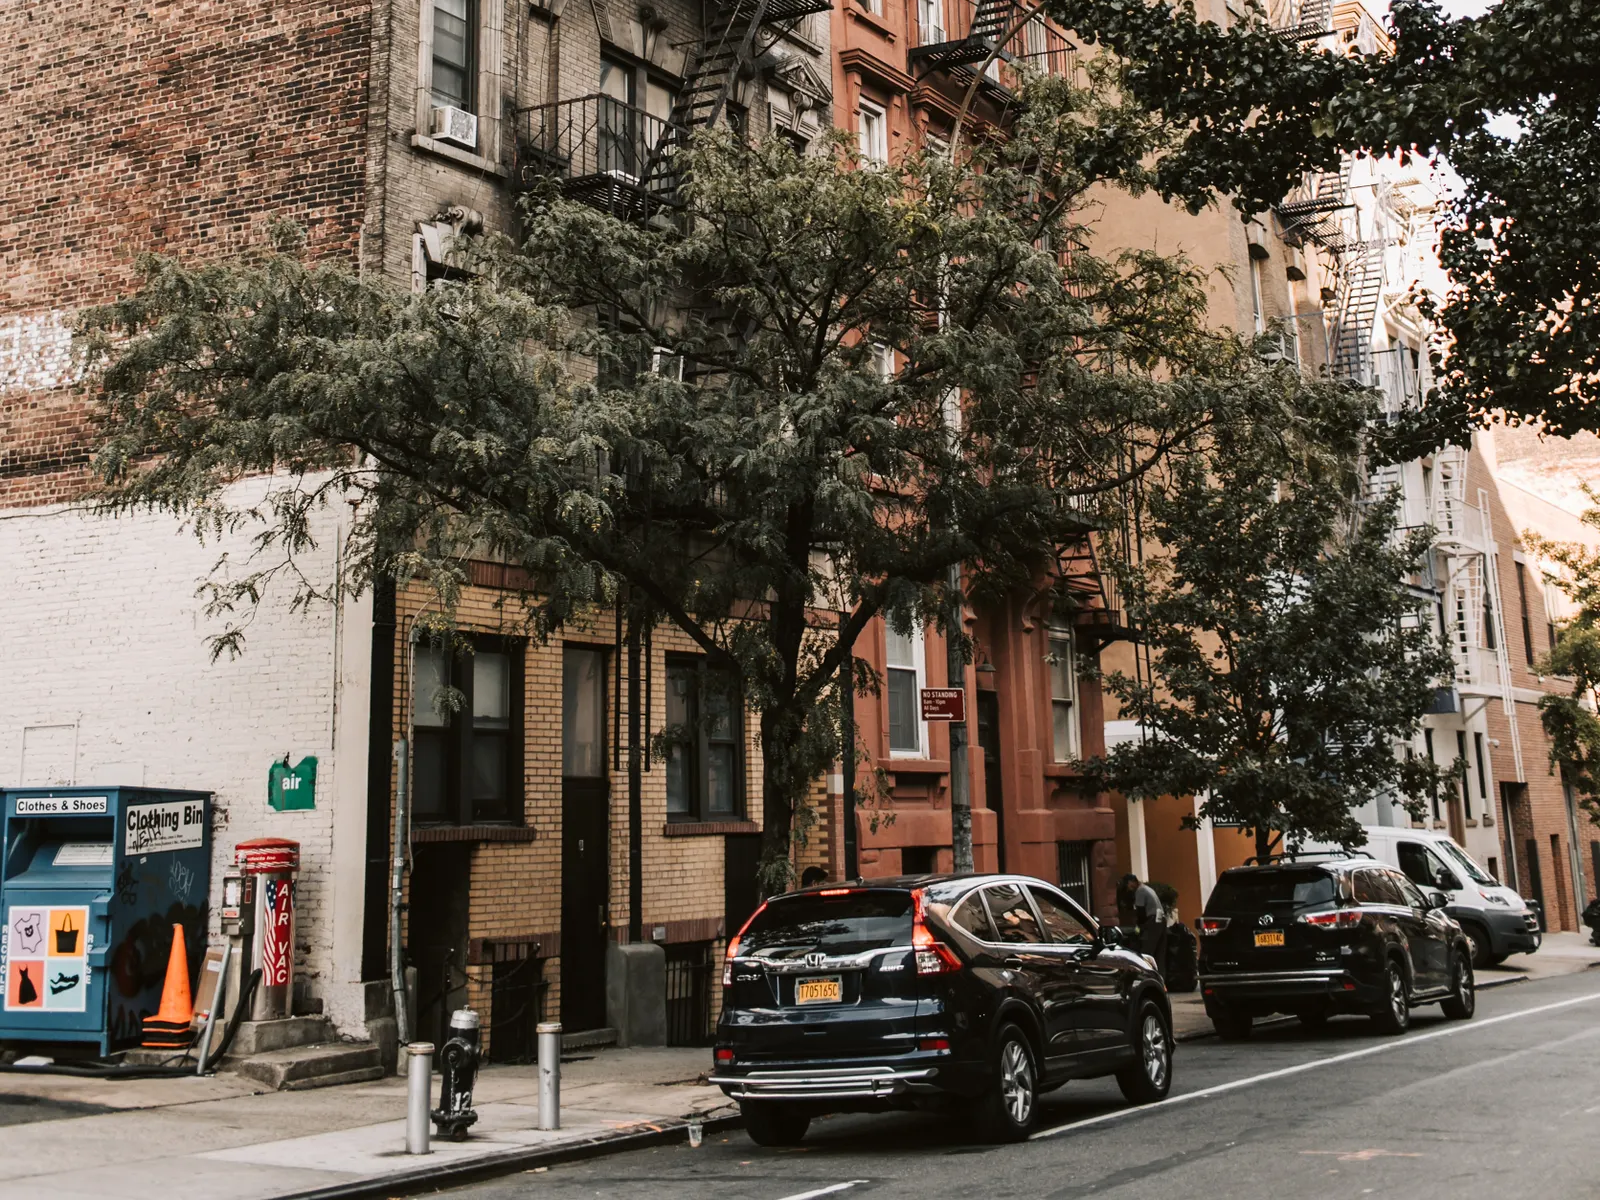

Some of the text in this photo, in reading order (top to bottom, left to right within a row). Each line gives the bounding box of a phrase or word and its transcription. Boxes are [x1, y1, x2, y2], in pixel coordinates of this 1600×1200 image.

[282, 773, 302, 790] air
[17, 800, 105, 812] Clothes & Shoes
[127, 805, 203, 832] Clothing Bin
[276, 883, 289, 983] AIR VAC
[0, 925, 9, 995] RECYCLE
[800, 984, 837, 999] T705165C
[453, 1091, 471, 1112] 12
